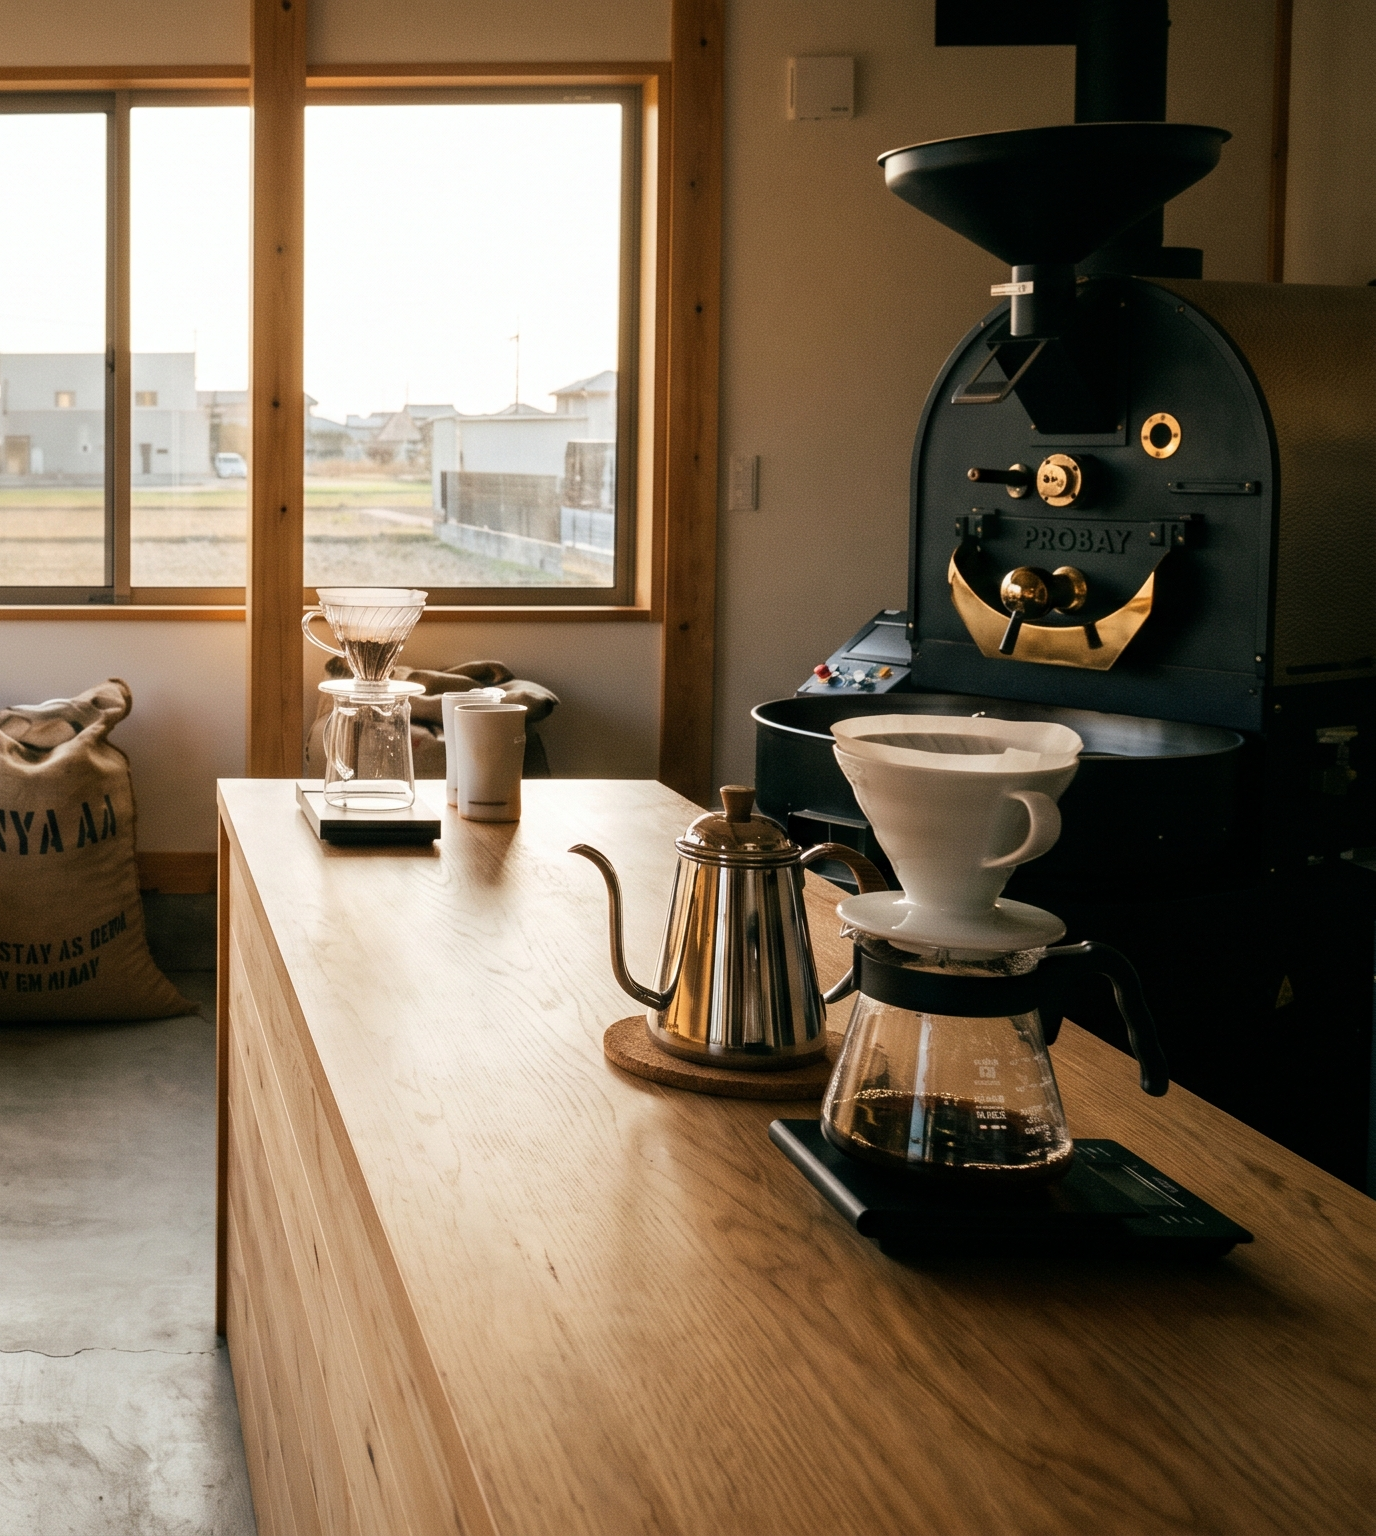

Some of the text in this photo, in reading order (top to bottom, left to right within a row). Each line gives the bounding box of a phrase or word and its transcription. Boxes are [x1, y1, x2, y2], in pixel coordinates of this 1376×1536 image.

[1024, 526, 1132, 555] PROBAY
[76, 794, 117, 849] AA
[58, 936, 84, 962] AS
